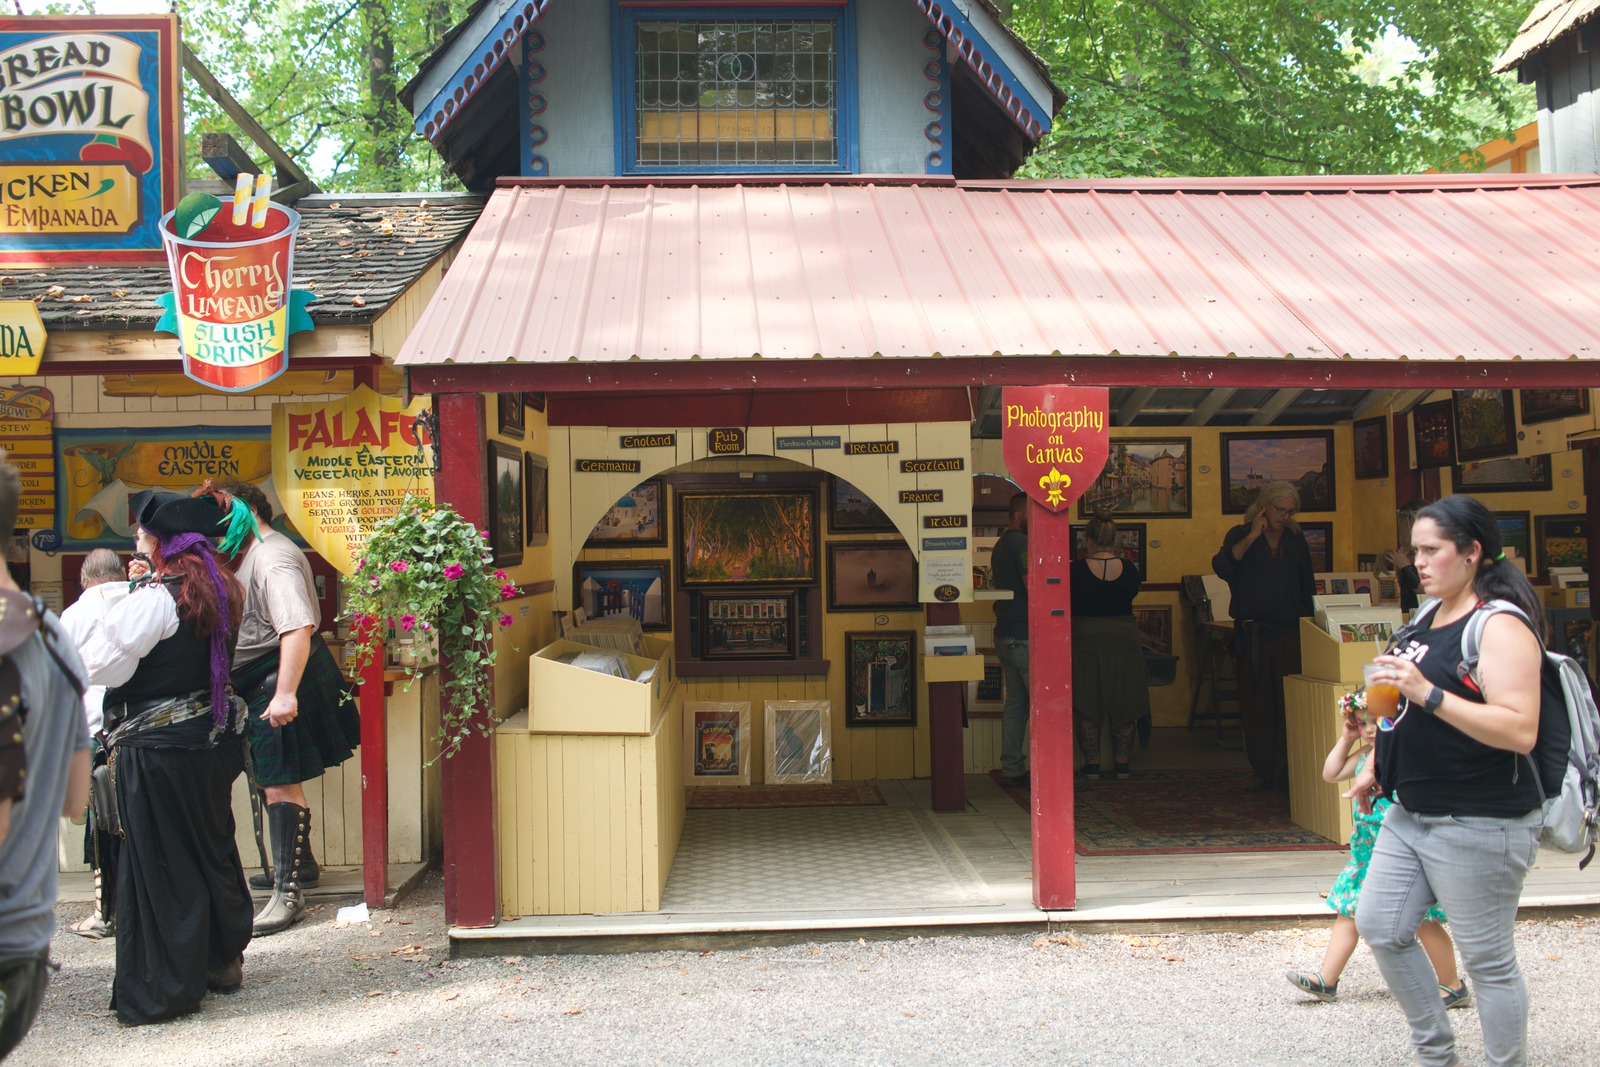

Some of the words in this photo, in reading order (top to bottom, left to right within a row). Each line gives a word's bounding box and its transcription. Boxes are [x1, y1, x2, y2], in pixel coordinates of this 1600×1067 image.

[0, 41, 111, 92] READ
[2, 82, 136, 131] BOWL
[5, 204, 119, 231] EMPANADA
[180, 251, 286, 296] Cherry
[186, 292, 283, 319] LIMEADE
[193, 320, 276, 344] SLUSH
[195, 339, 280, 364] DRINK
[1007, 405, 1103, 433] Photography
[1, 424, 30, 432] STEW
[624, 436, 671, 448] England
[715, 431, 738, 442] Pub
[1048, 435, 1064, 445] on
[164, 441, 233, 461] MIDDLE
[356, 444, 370, 454] A
[715, 442, 739, 451] Room
[850, 442, 895, 454] Ireland
[1026, 443, 1084, 464] Canvas
[307, 455, 352, 467] MIDDLE
[358, 454, 424, 467] EASTERN
[581, 461, 636, 472] Germany
[905, 459, 960, 472] Scotland
[158, 459, 239, 477] EASTERN
[294, 467, 379, 480] VEGETARIAN
[374, 489, 394, 497] AND
[902, 492, 940, 503] France
[302, 500, 335, 508] SPICES
[339, 499, 375, 508] GROUND
[309, 508, 343, 517] SERVED
[346, 508, 359, 516] AS
[361, 507, 394, 515] GOLDEN
[321, 517, 345, 525] ATOP
[930, 516, 962, 527] Italy
